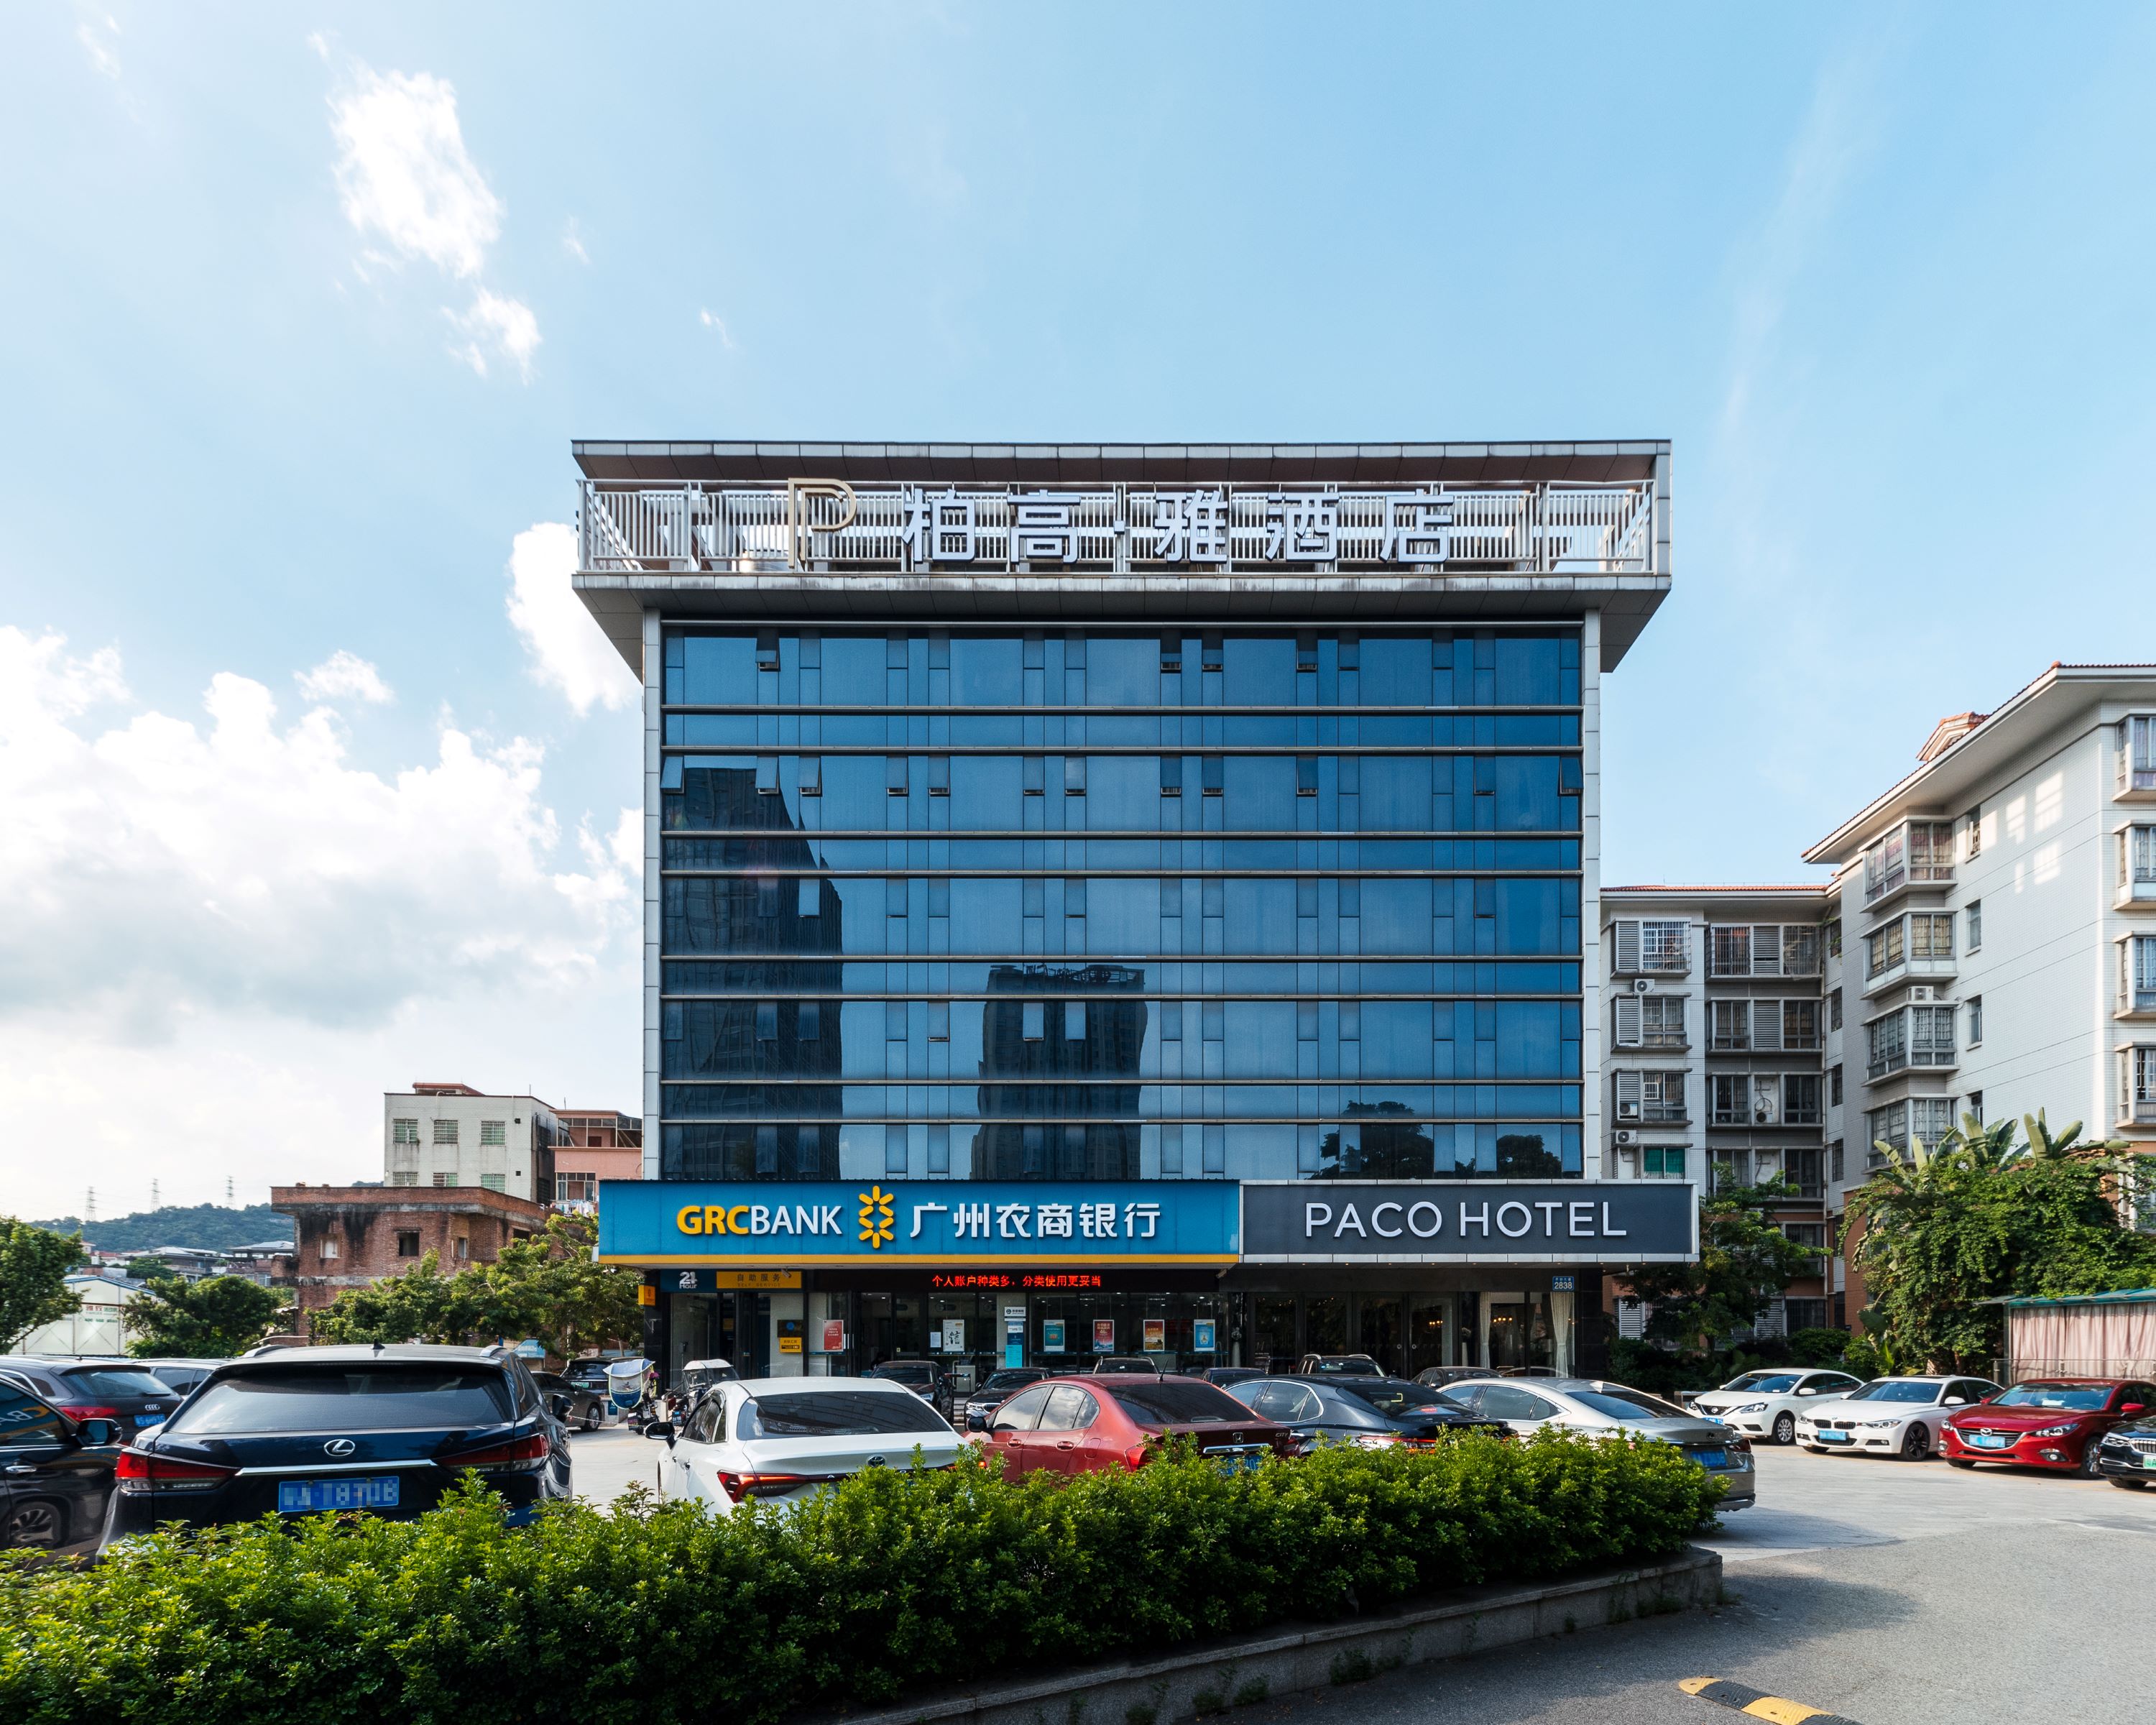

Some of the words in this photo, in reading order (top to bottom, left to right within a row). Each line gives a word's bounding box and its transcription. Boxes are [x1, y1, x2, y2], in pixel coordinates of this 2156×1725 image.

[788, 477, 857, 569] P
[676, 1205, 843, 1235] GRCBANK
[910, 1202, 1161, 1238] 广州农商银行
[1305, 1201, 1442, 1238] PACO
[1460, 1201, 1627, 1238] HOTEL
[679, 1271, 698, 1284] 24
